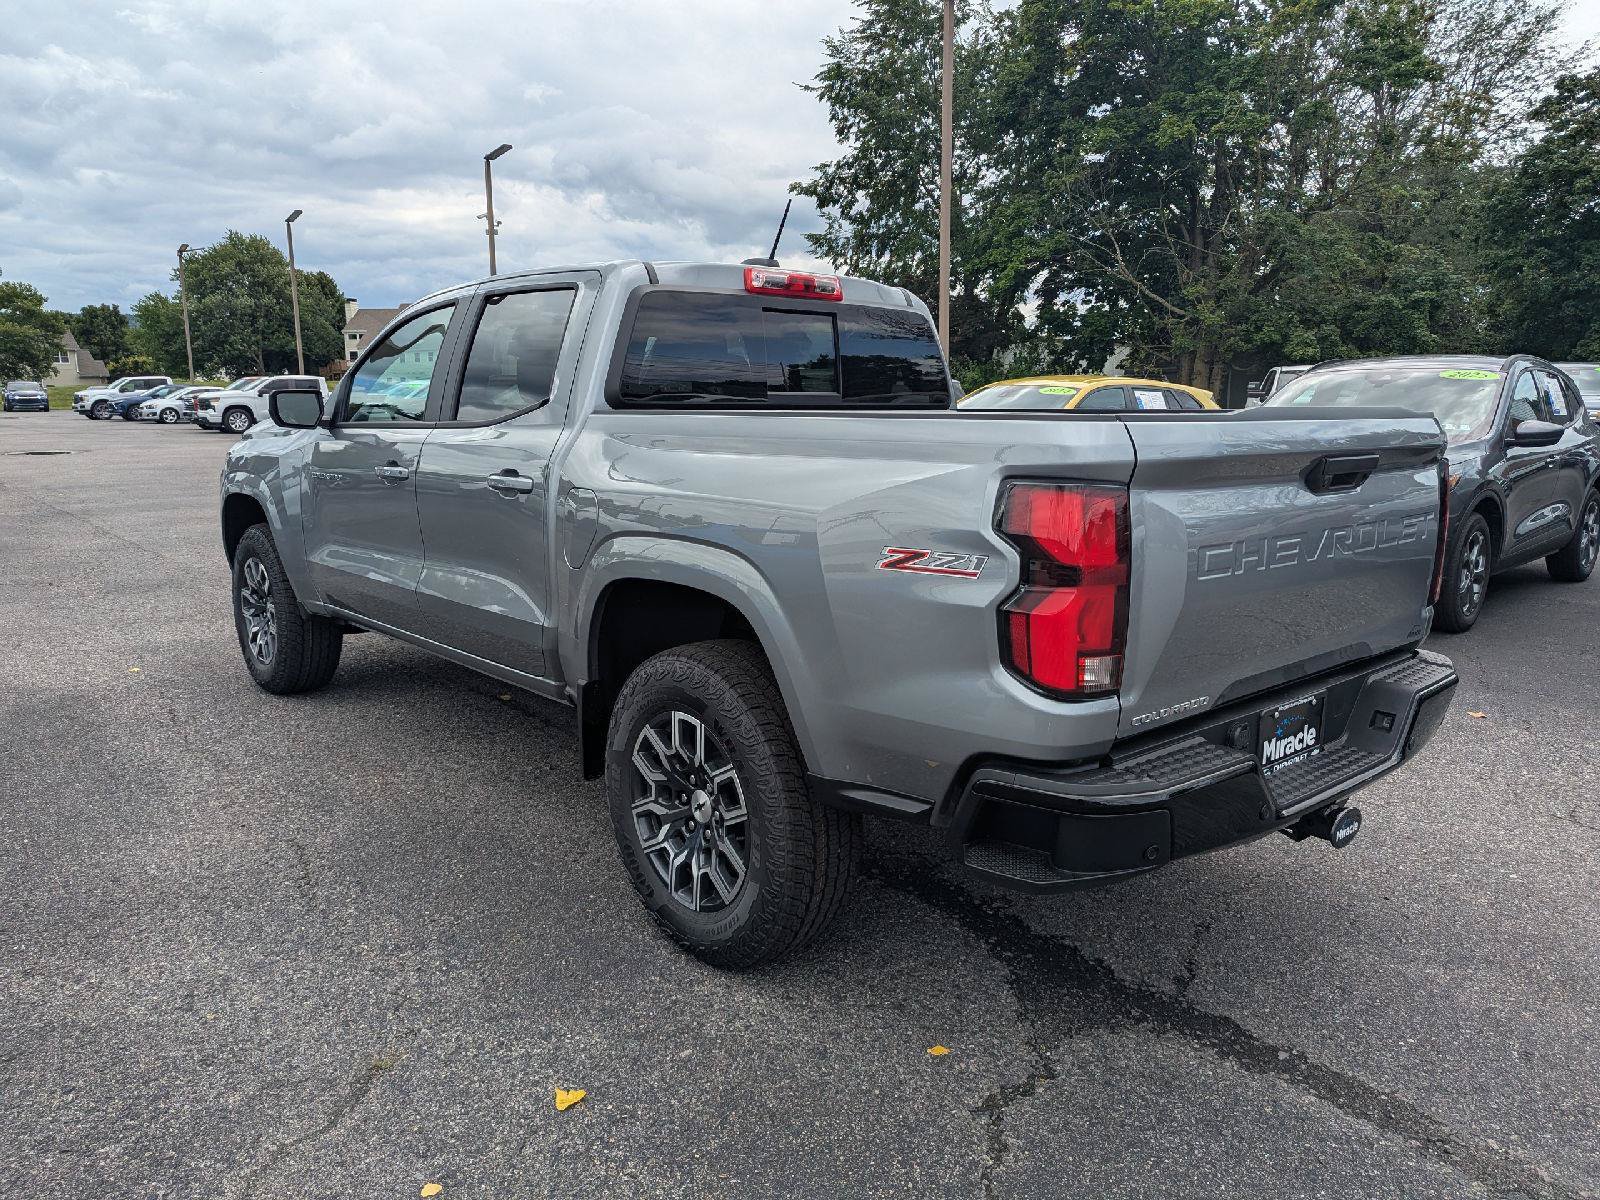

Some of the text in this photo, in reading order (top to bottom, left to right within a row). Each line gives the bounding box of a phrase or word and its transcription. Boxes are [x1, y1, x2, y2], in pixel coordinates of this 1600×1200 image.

[1197, 511, 1434, 580] CHEVROLET
[874, 546, 990, 580] Z71
[1131, 695, 1210, 727] COLORADO
[1262, 724, 1317, 765] Miracle
[1335, 820, 1359, 842] Miracle
